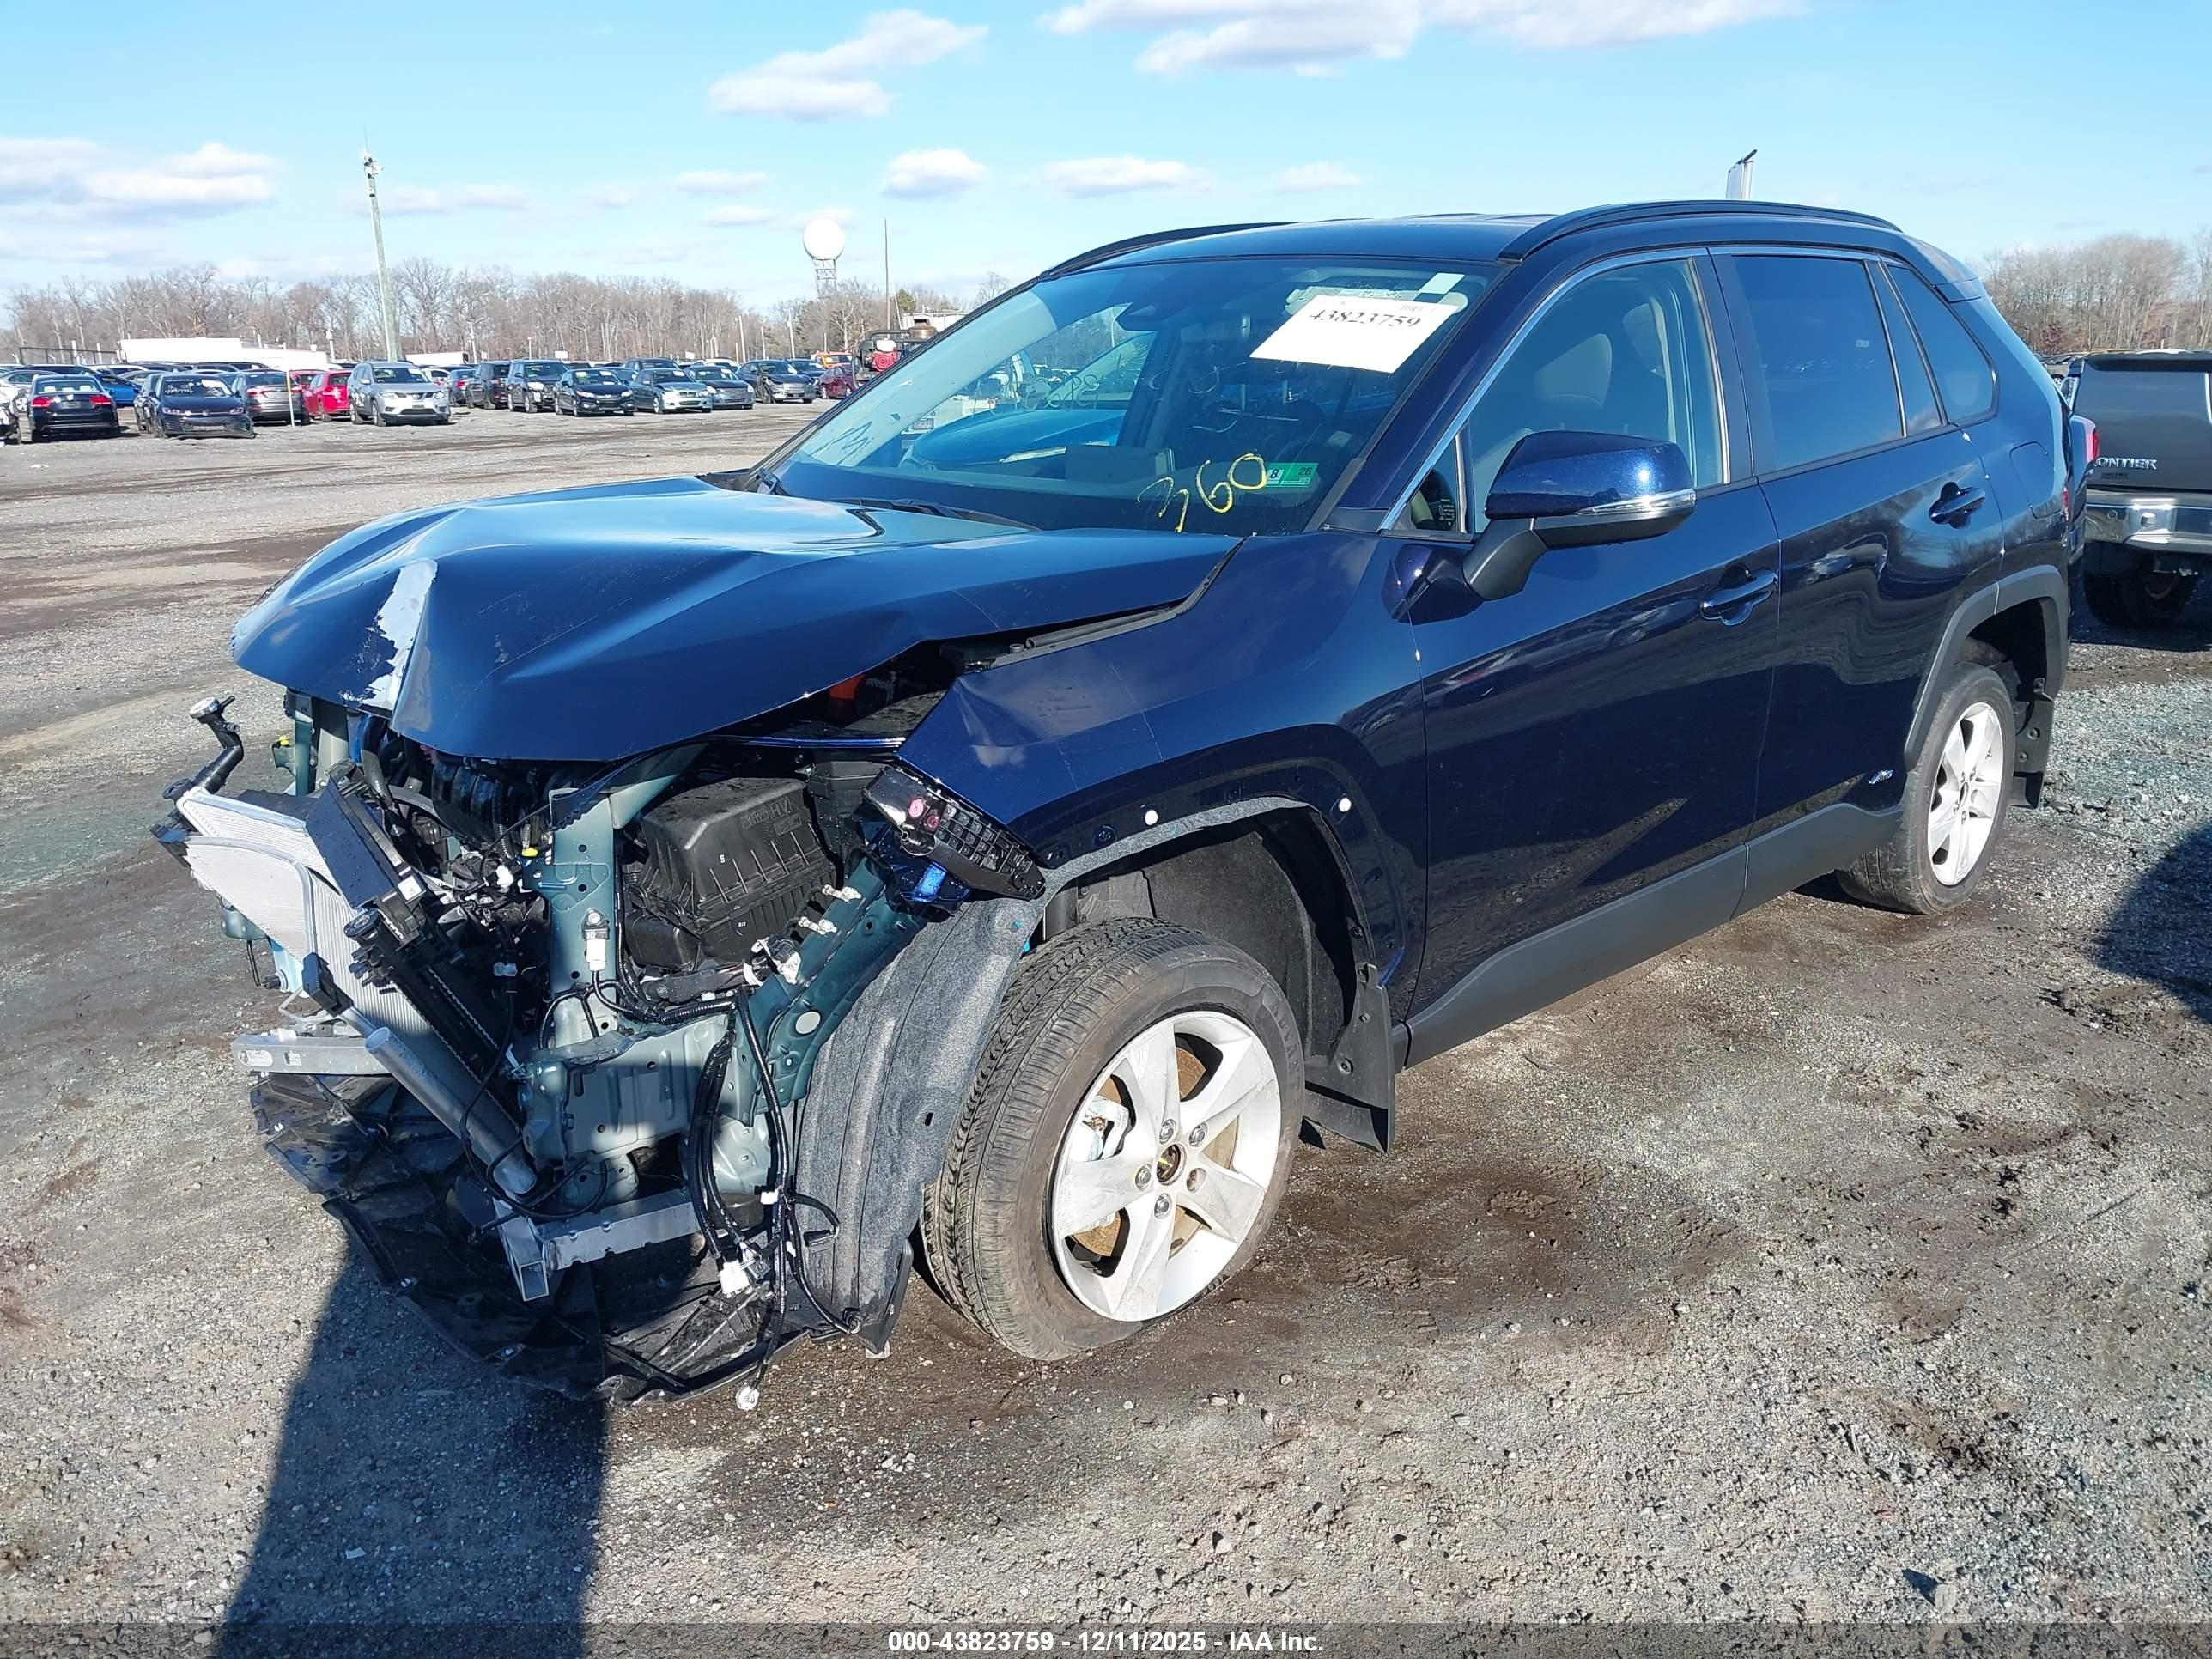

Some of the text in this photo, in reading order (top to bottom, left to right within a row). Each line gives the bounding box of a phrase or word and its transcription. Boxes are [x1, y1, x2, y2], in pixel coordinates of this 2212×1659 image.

[1309, 309, 1422, 328] 43823759
[2094, 457, 2157, 470] ONTIER
[1298, 467, 1312, 476] 26
